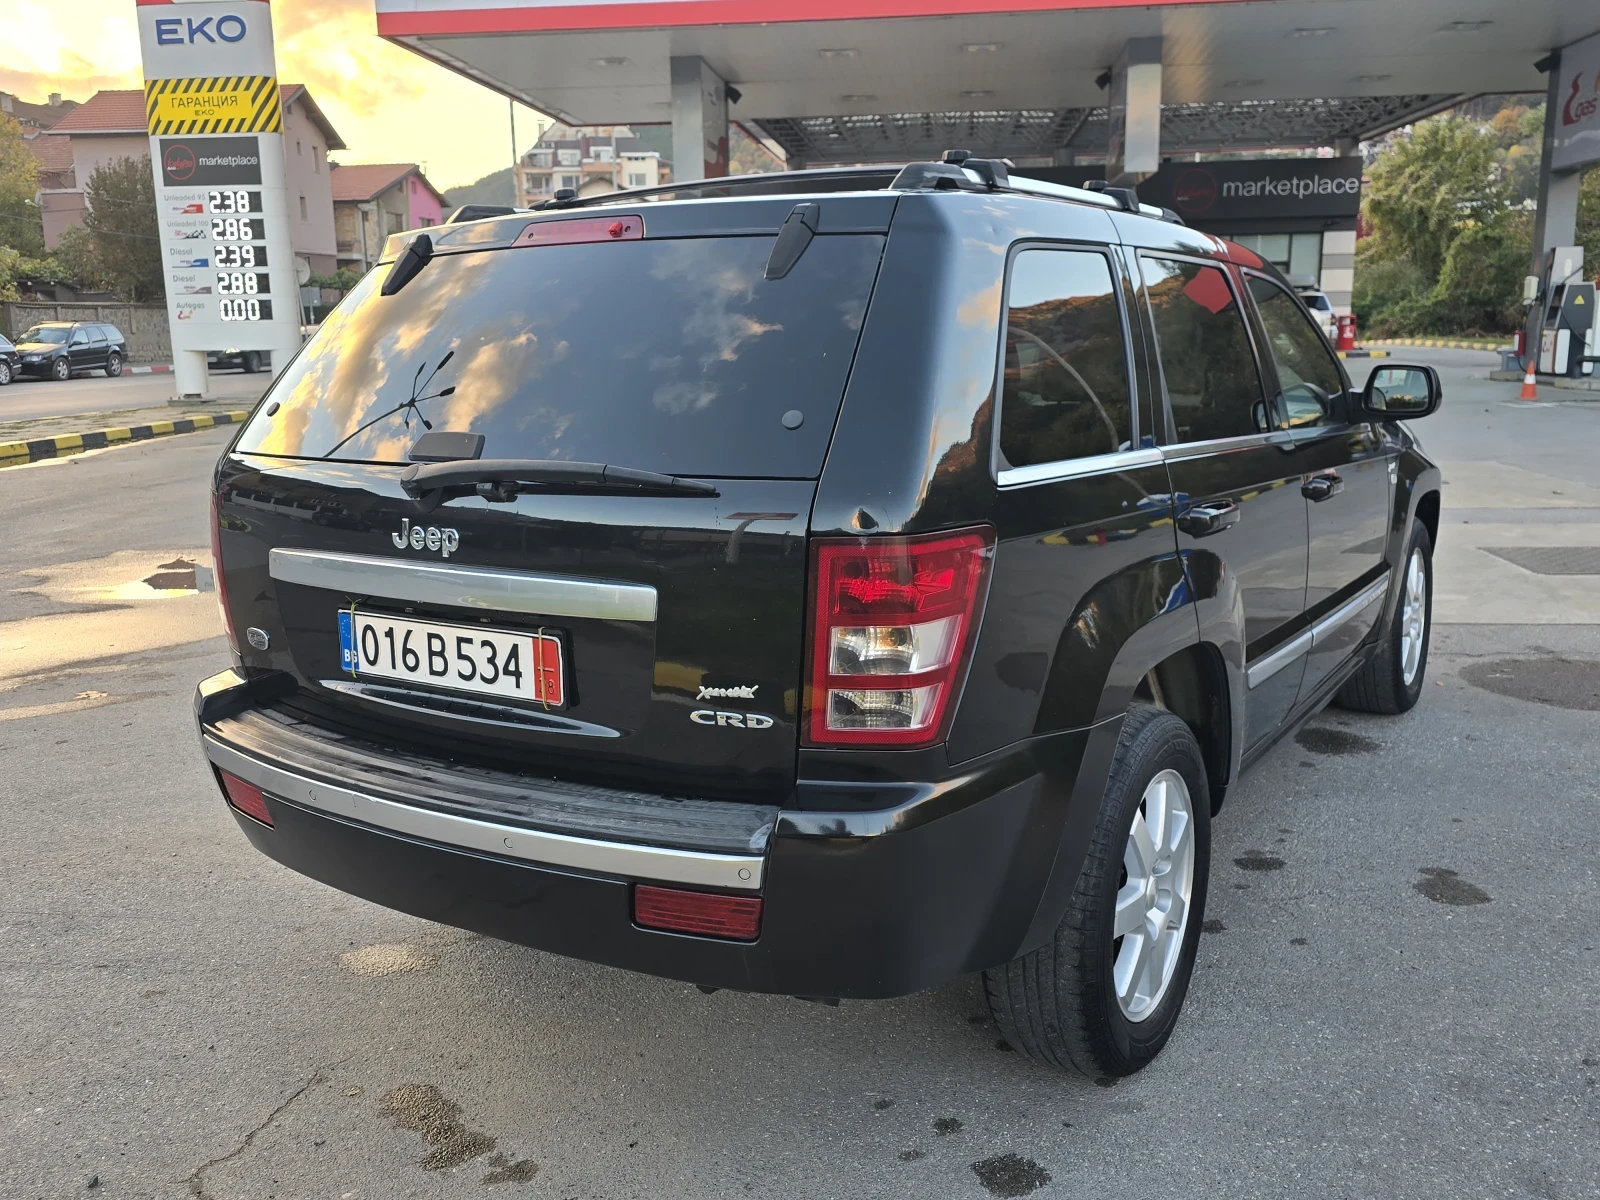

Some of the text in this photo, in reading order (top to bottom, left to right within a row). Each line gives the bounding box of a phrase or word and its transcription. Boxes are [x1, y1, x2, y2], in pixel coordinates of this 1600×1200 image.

[155, 14, 247, 45] EKO
[171, 95, 238, 109] ГАРАНЦИЯ
[194, 108, 216, 117] EKO
[198, 154, 259, 168] marketplace
[1222, 174, 1360, 200] marketplace
[164, 194, 195, 202] Unleaded
[209, 190, 250, 214] 2.38
[166, 220, 197, 228] Unleaded
[211, 218, 253, 241] 2.86
[169, 247, 193, 256] Diesel
[214, 245, 255, 268] 2.39
[172, 274, 196, 283] Diesel
[217, 272, 258, 295] 2.88
[176, 301, 205, 310] Autogas
[391, 517, 460, 558] Jeep
[343, 648, 359, 663] BG
[360, 622, 523, 689] 016B534
[689, 709, 775, 729] CRD
